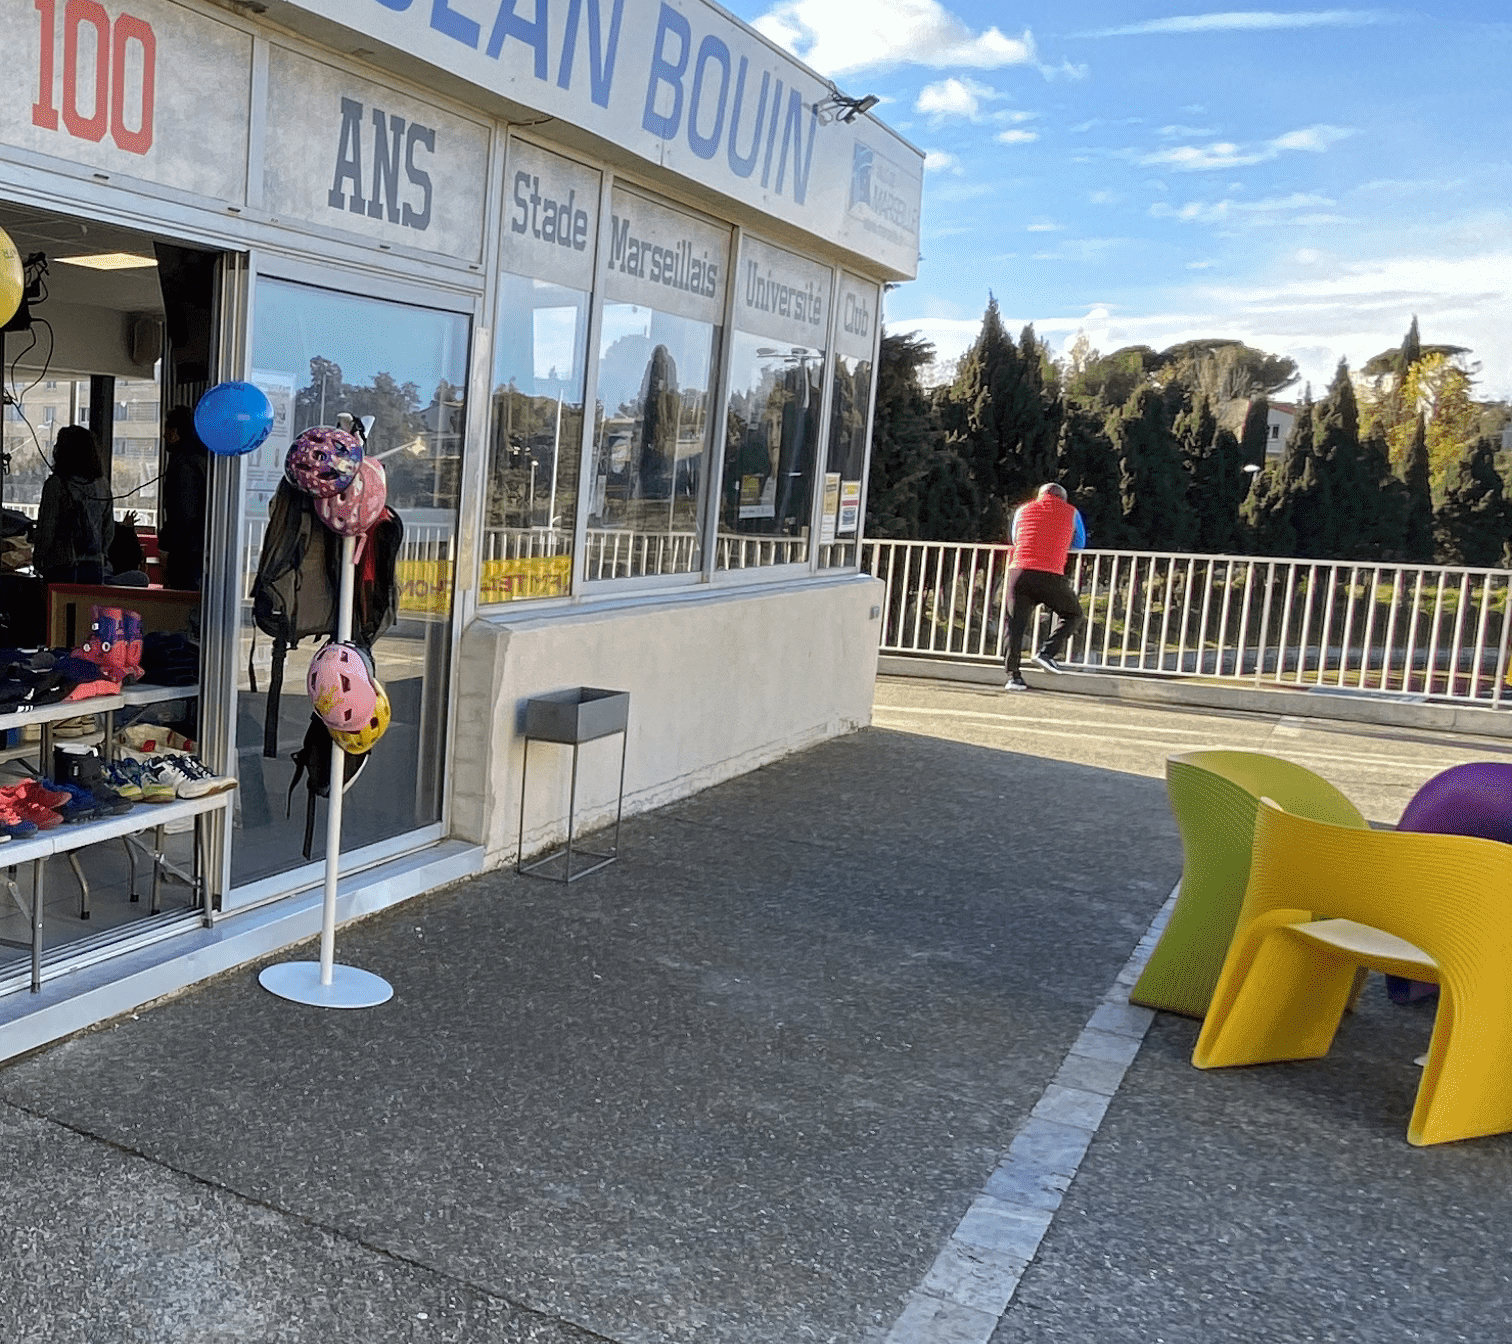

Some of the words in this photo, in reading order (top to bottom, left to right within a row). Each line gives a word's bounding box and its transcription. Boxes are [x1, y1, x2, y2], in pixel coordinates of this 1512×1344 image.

[328, 95, 436, 231] ANS
[642, 1, 820, 206] BOUIN
[511, 170, 588, 252] Stade
[608, 214, 718, 299] Marseillais
[745, 260, 823, 326] Université
[843, 292, 870, 337] Club
